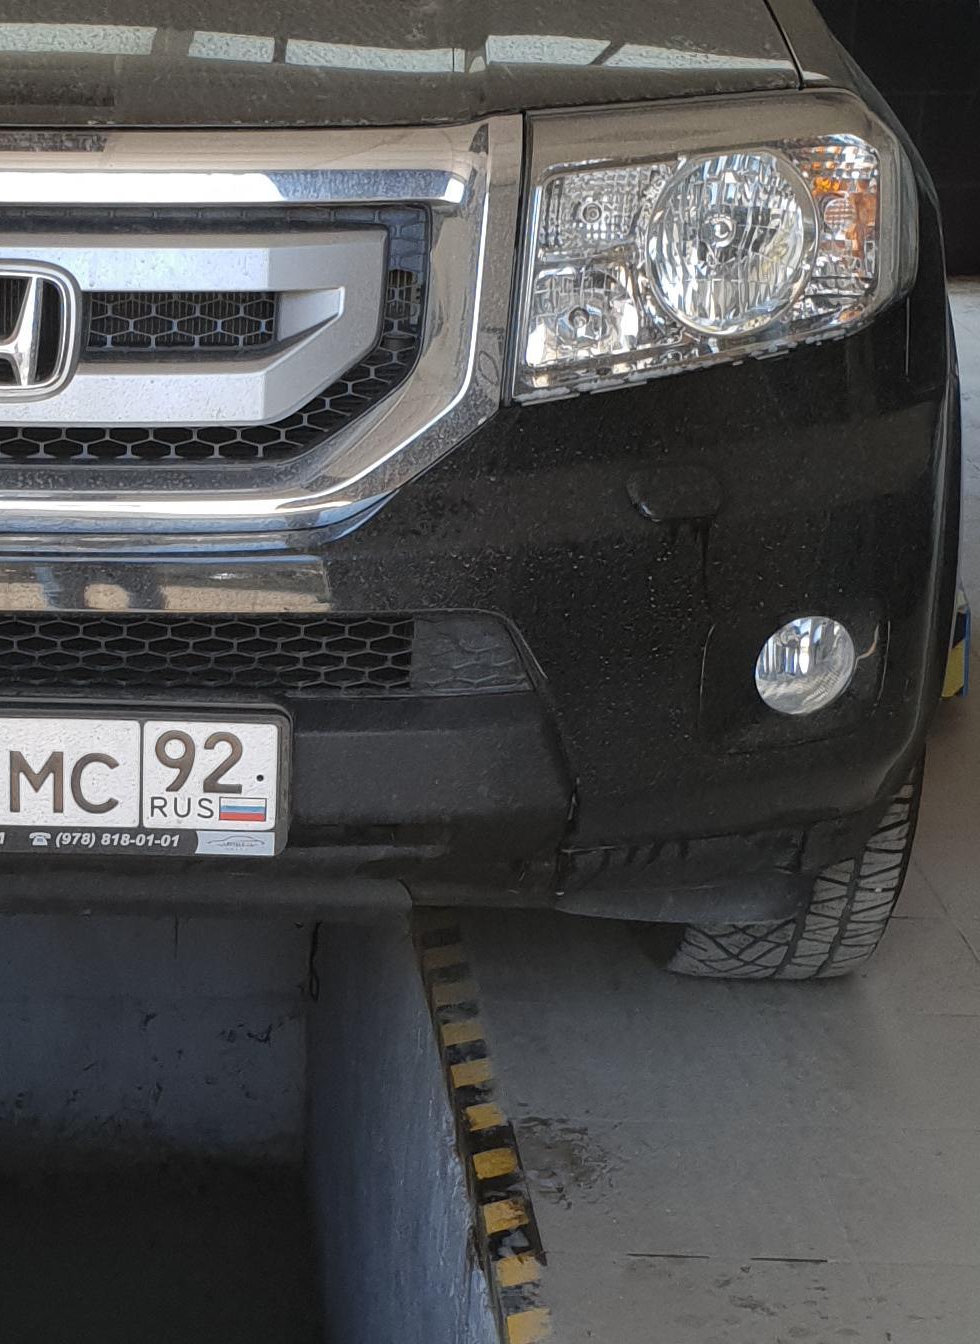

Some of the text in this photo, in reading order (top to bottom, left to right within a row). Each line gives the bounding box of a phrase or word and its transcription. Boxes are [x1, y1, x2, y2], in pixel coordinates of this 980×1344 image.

[153, 729, 244, 795] 92
[150, 796, 214, 821] RUS
[55, 831, 96, 849] (978)
[100, 832, 180, 848] 818-01-01
